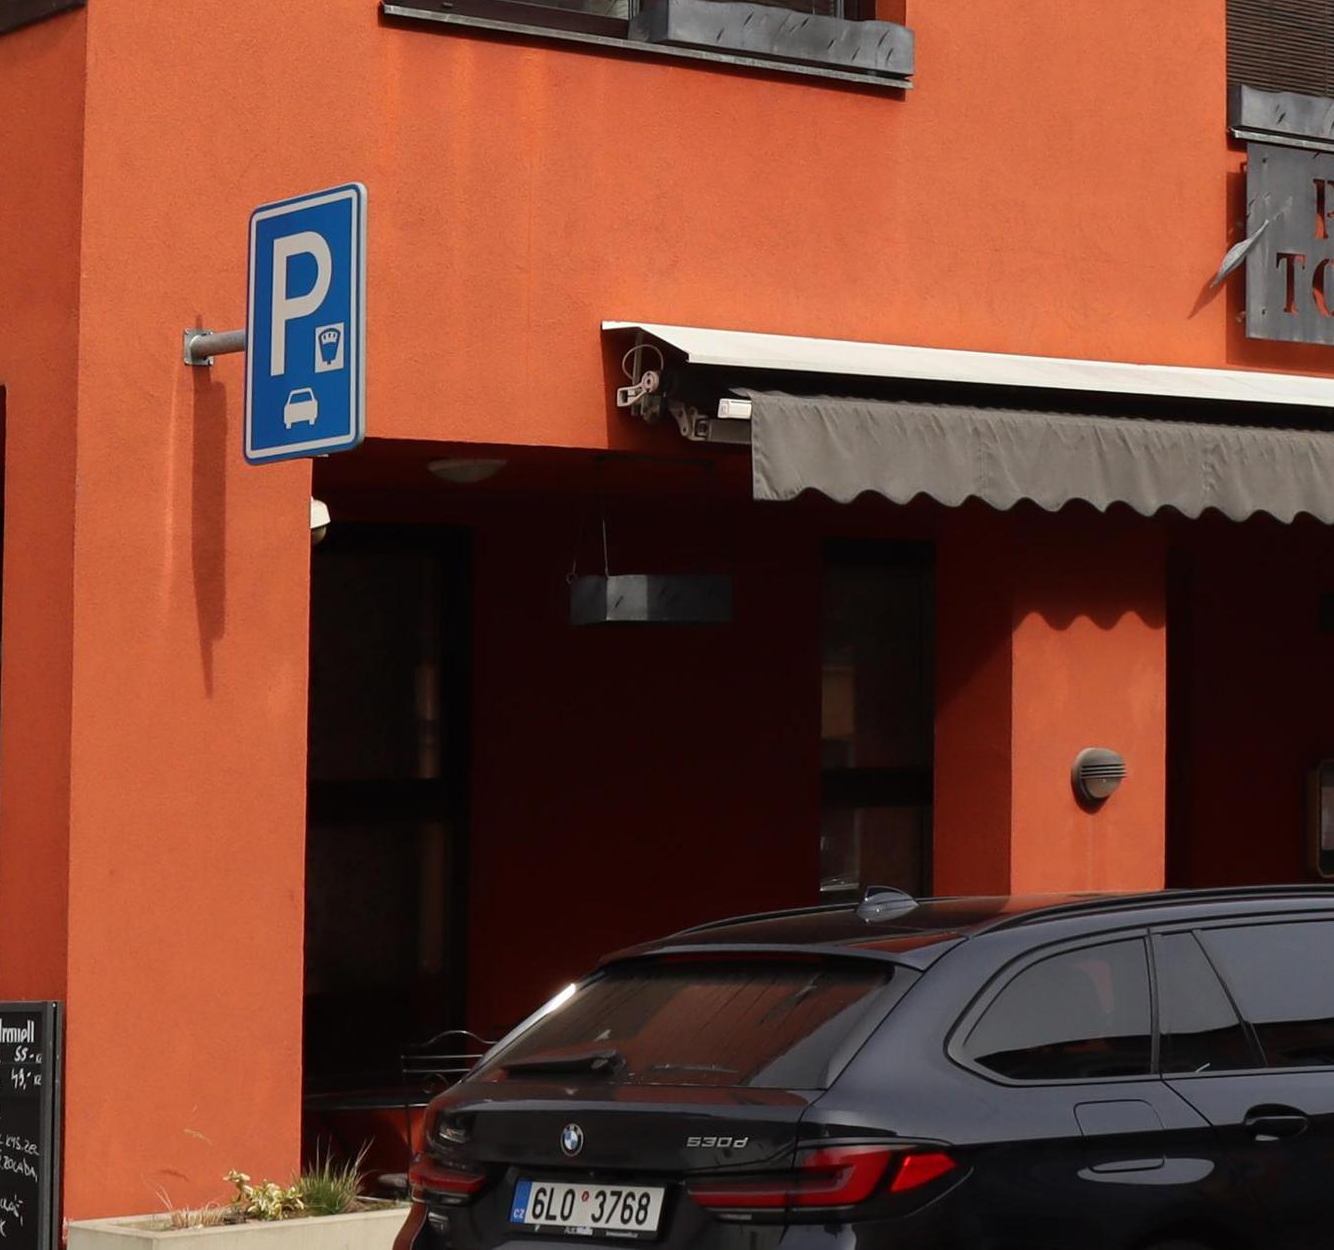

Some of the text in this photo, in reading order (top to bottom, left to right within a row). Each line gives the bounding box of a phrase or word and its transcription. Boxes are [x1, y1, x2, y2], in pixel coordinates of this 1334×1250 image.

[270, 230, 332, 377] P
[686, 1135, 749, 1150] 530d
[512, 1186, 651, 1226] CZ 6L0 3768
